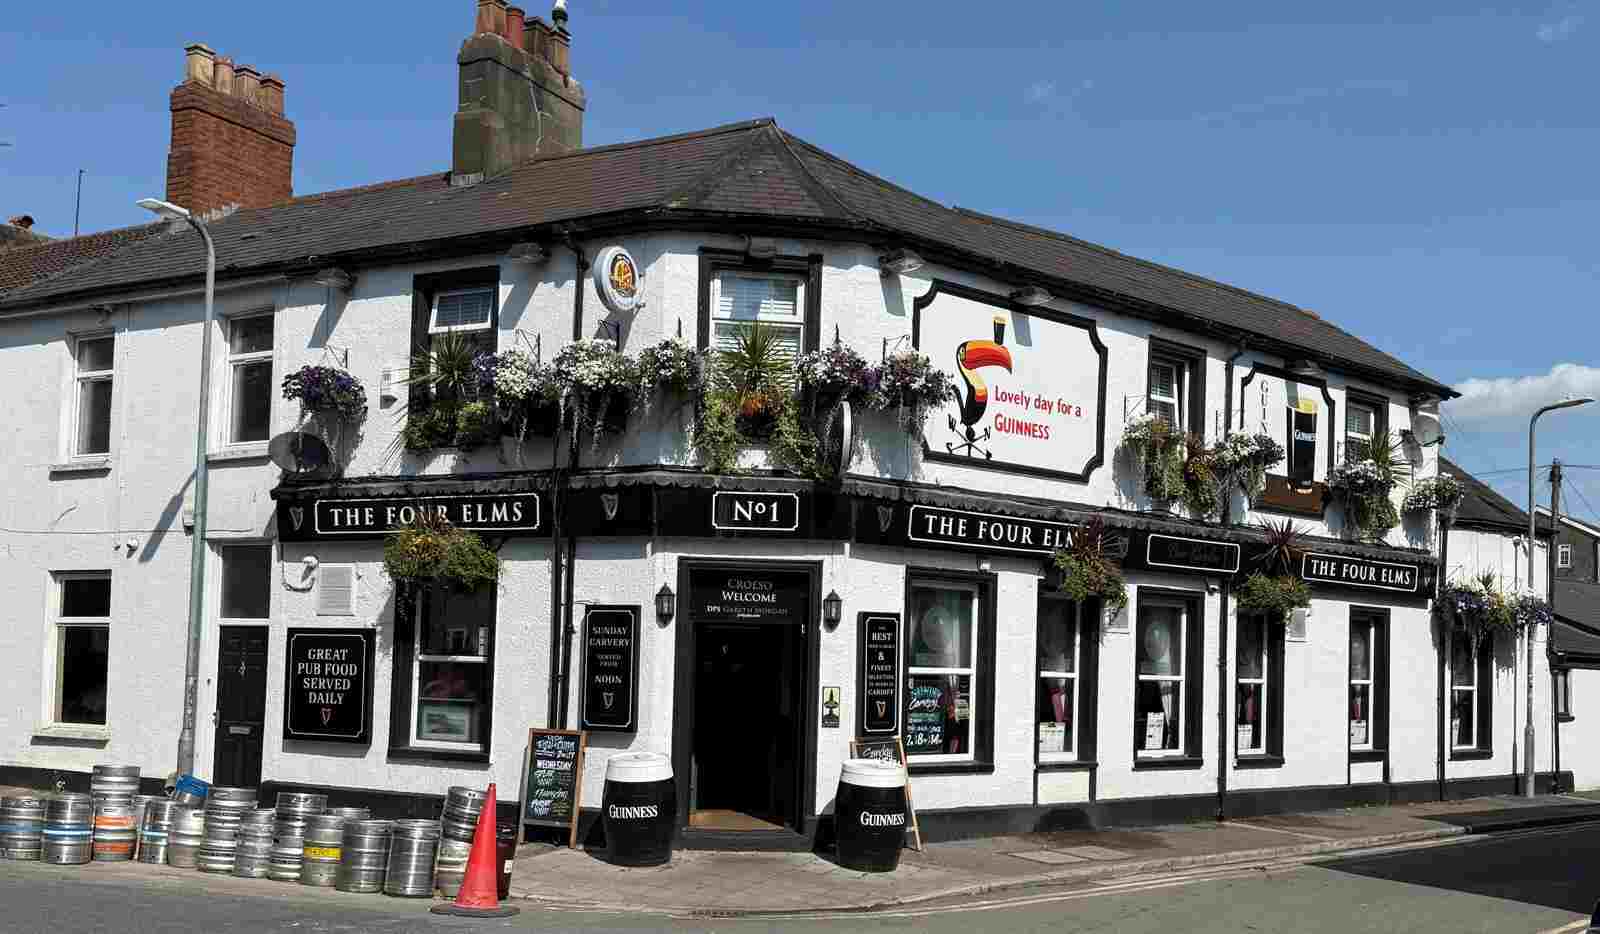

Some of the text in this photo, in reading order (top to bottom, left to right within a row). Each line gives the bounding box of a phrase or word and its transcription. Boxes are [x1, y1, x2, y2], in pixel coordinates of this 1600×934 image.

[995, 386, 1081, 417] Lovely day for a
[994, 414, 1049, 440] GUINNESS
[329, 502, 523, 526] THE FOUR ELMS
[925, 514, 1079, 549] THE FOUR ELM
[1311, 559, 1411, 586] THE FOUR ELMS
[721, 591, 777, 603] WELCOME
[592, 626, 628, 635] SUNDAY
[872, 632, 893, 640] BEST
[589, 638, 630, 647] CARVERY
[308, 648, 348, 661] GREAT
[297, 662, 358, 677] PUB FOOD
[303, 677, 351, 691] SERVED
[595, 675, 622, 684] NOON
[308, 692, 344, 705] DAILY
[609, 804, 658, 819] GUINNESS
[860, 811, 905, 826] GUINNESS
